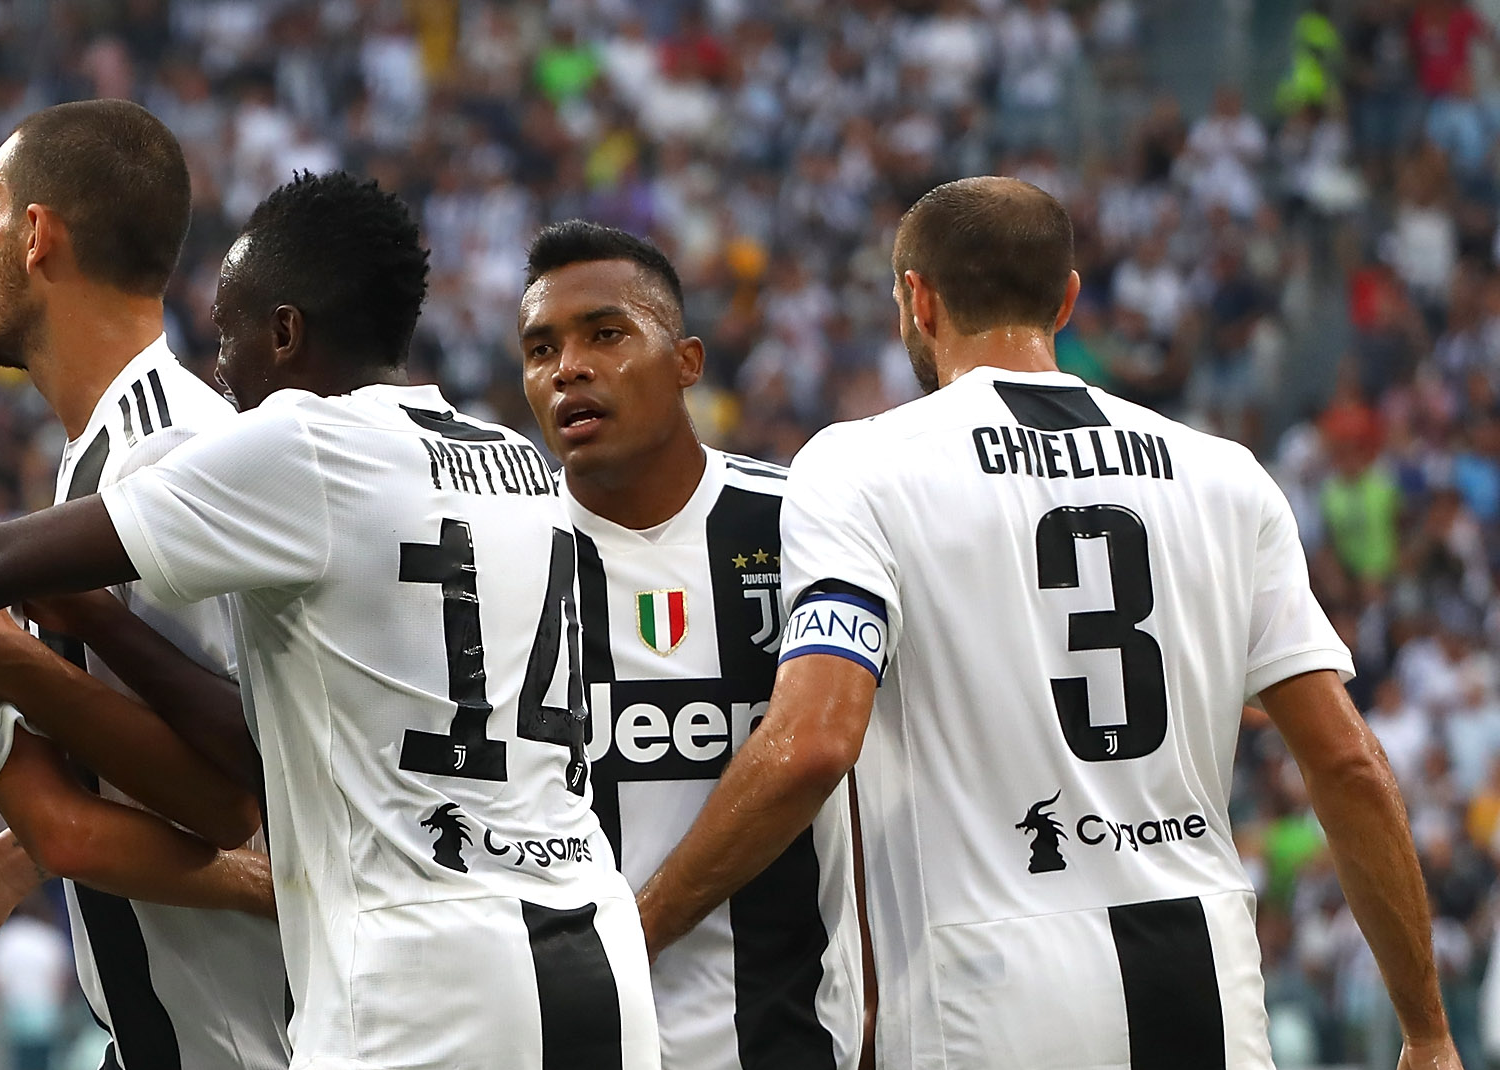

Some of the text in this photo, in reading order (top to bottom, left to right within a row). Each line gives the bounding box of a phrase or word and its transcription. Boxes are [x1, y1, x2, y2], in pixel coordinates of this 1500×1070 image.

[972, 426, 1174, 480] CHIELLINI
[399, 517, 587, 796] 14
[1036, 504, 1168, 763] 3
[483, 828, 593, 868] Cygames
